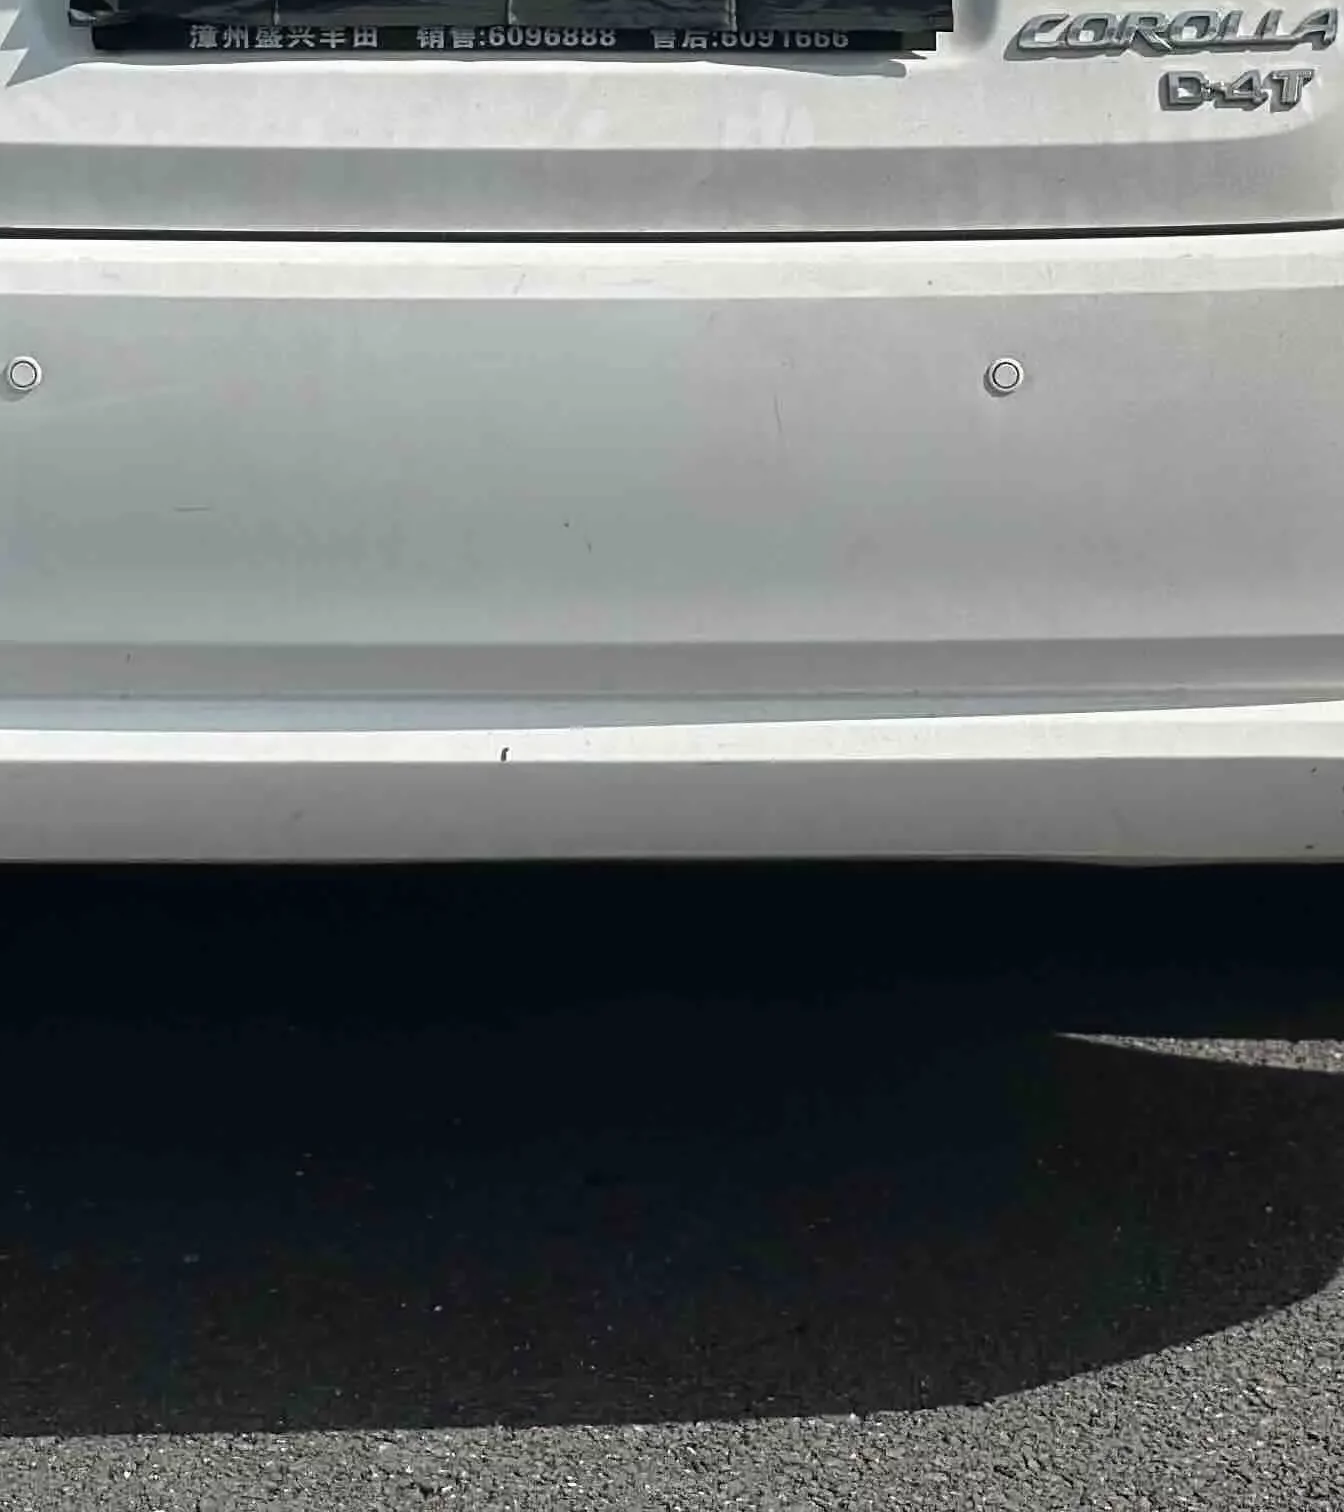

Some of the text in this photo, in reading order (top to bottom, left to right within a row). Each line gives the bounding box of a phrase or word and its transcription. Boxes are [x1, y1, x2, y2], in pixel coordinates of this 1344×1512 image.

[189, 23, 379, 49] 漳州盛兴丰田
[1015, 7, 1339, 51] COROLLA
[1165, 68, 1315, 107] D-4T
